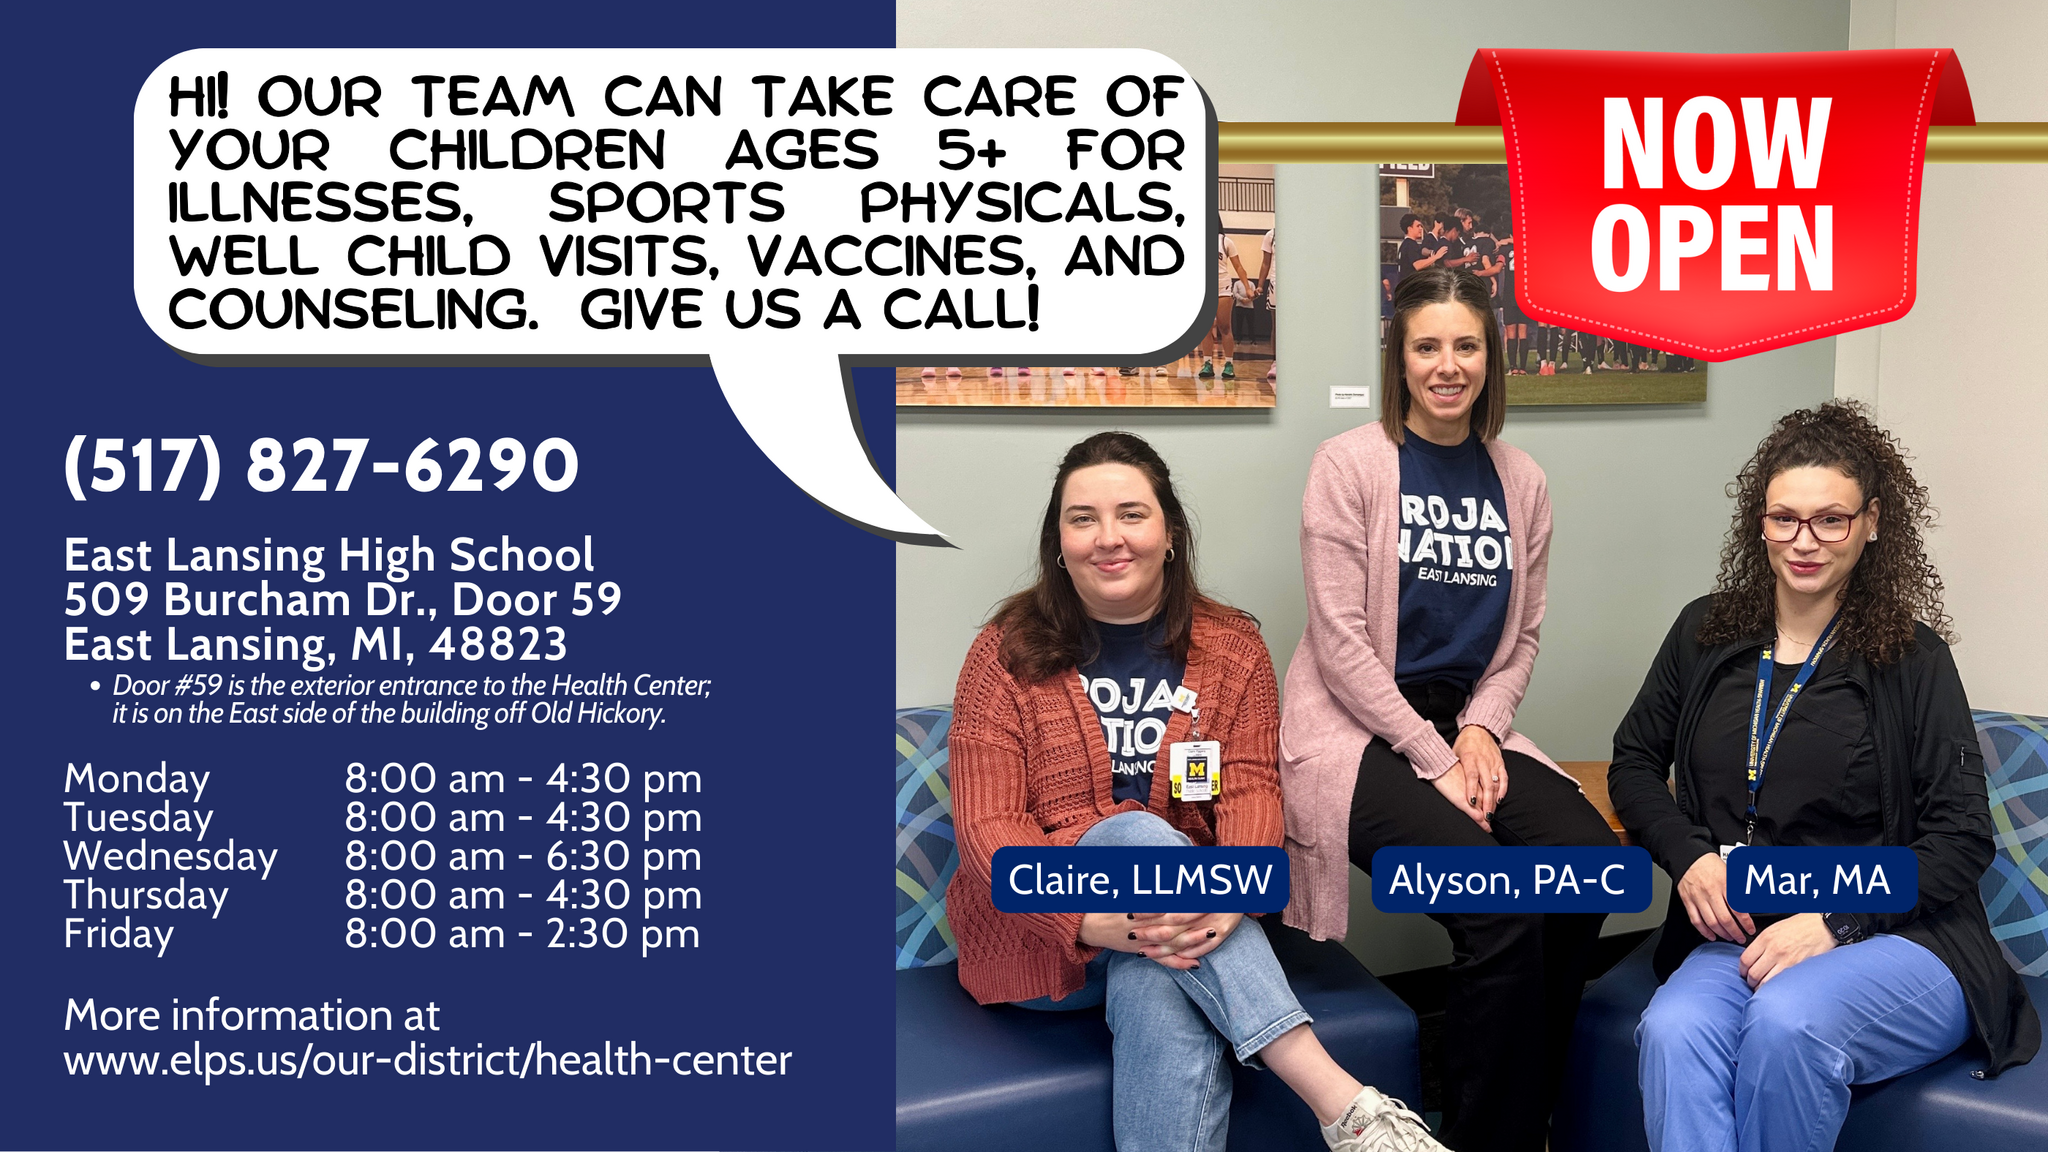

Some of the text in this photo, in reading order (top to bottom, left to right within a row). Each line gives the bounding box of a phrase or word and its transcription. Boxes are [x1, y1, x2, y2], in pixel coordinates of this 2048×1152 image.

[1400, 492, 1508, 533] ROJA
[1417, 567, 1498, 587] EAST LANSING
[1078, 673, 1175, 715] OJA
[1189, 762, 1205, 776] M
[1340, 1104, 1358, 1129] Reebok
